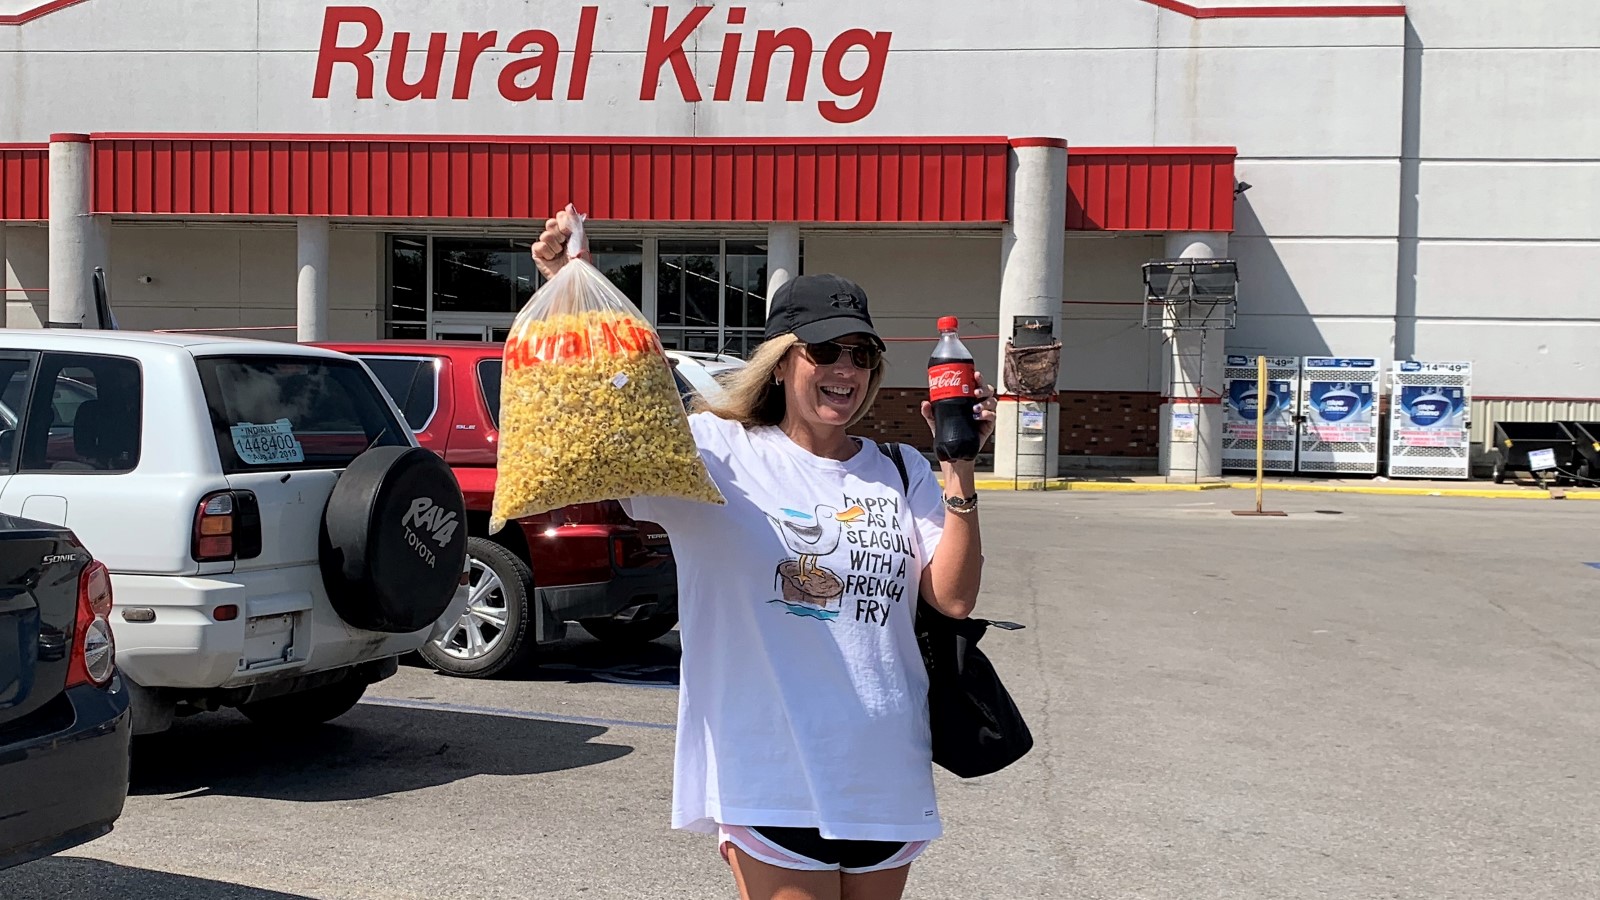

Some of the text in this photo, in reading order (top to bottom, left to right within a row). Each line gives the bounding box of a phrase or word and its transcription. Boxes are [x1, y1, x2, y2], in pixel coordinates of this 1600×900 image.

[312, 6, 892, 124] Rural King
[601, 318, 661, 354] Kin
[237, 435, 294, 453] 1448400
[245, 426, 276, 435] INDIANA
[279, 449, 297, 459] 2019
[401, 496, 459, 547] RAV4
[867, 512, 901, 531] AS A
[404, 526, 436, 569] TOYOTA
[846, 530, 915, 559] SEAGULL
[42, 554, 76, 565] SONIC
[850, 549, 906, 579] WITH A
[845, 574, 905, 603] FRENCH
[855, 599, 890, 627] FRY
